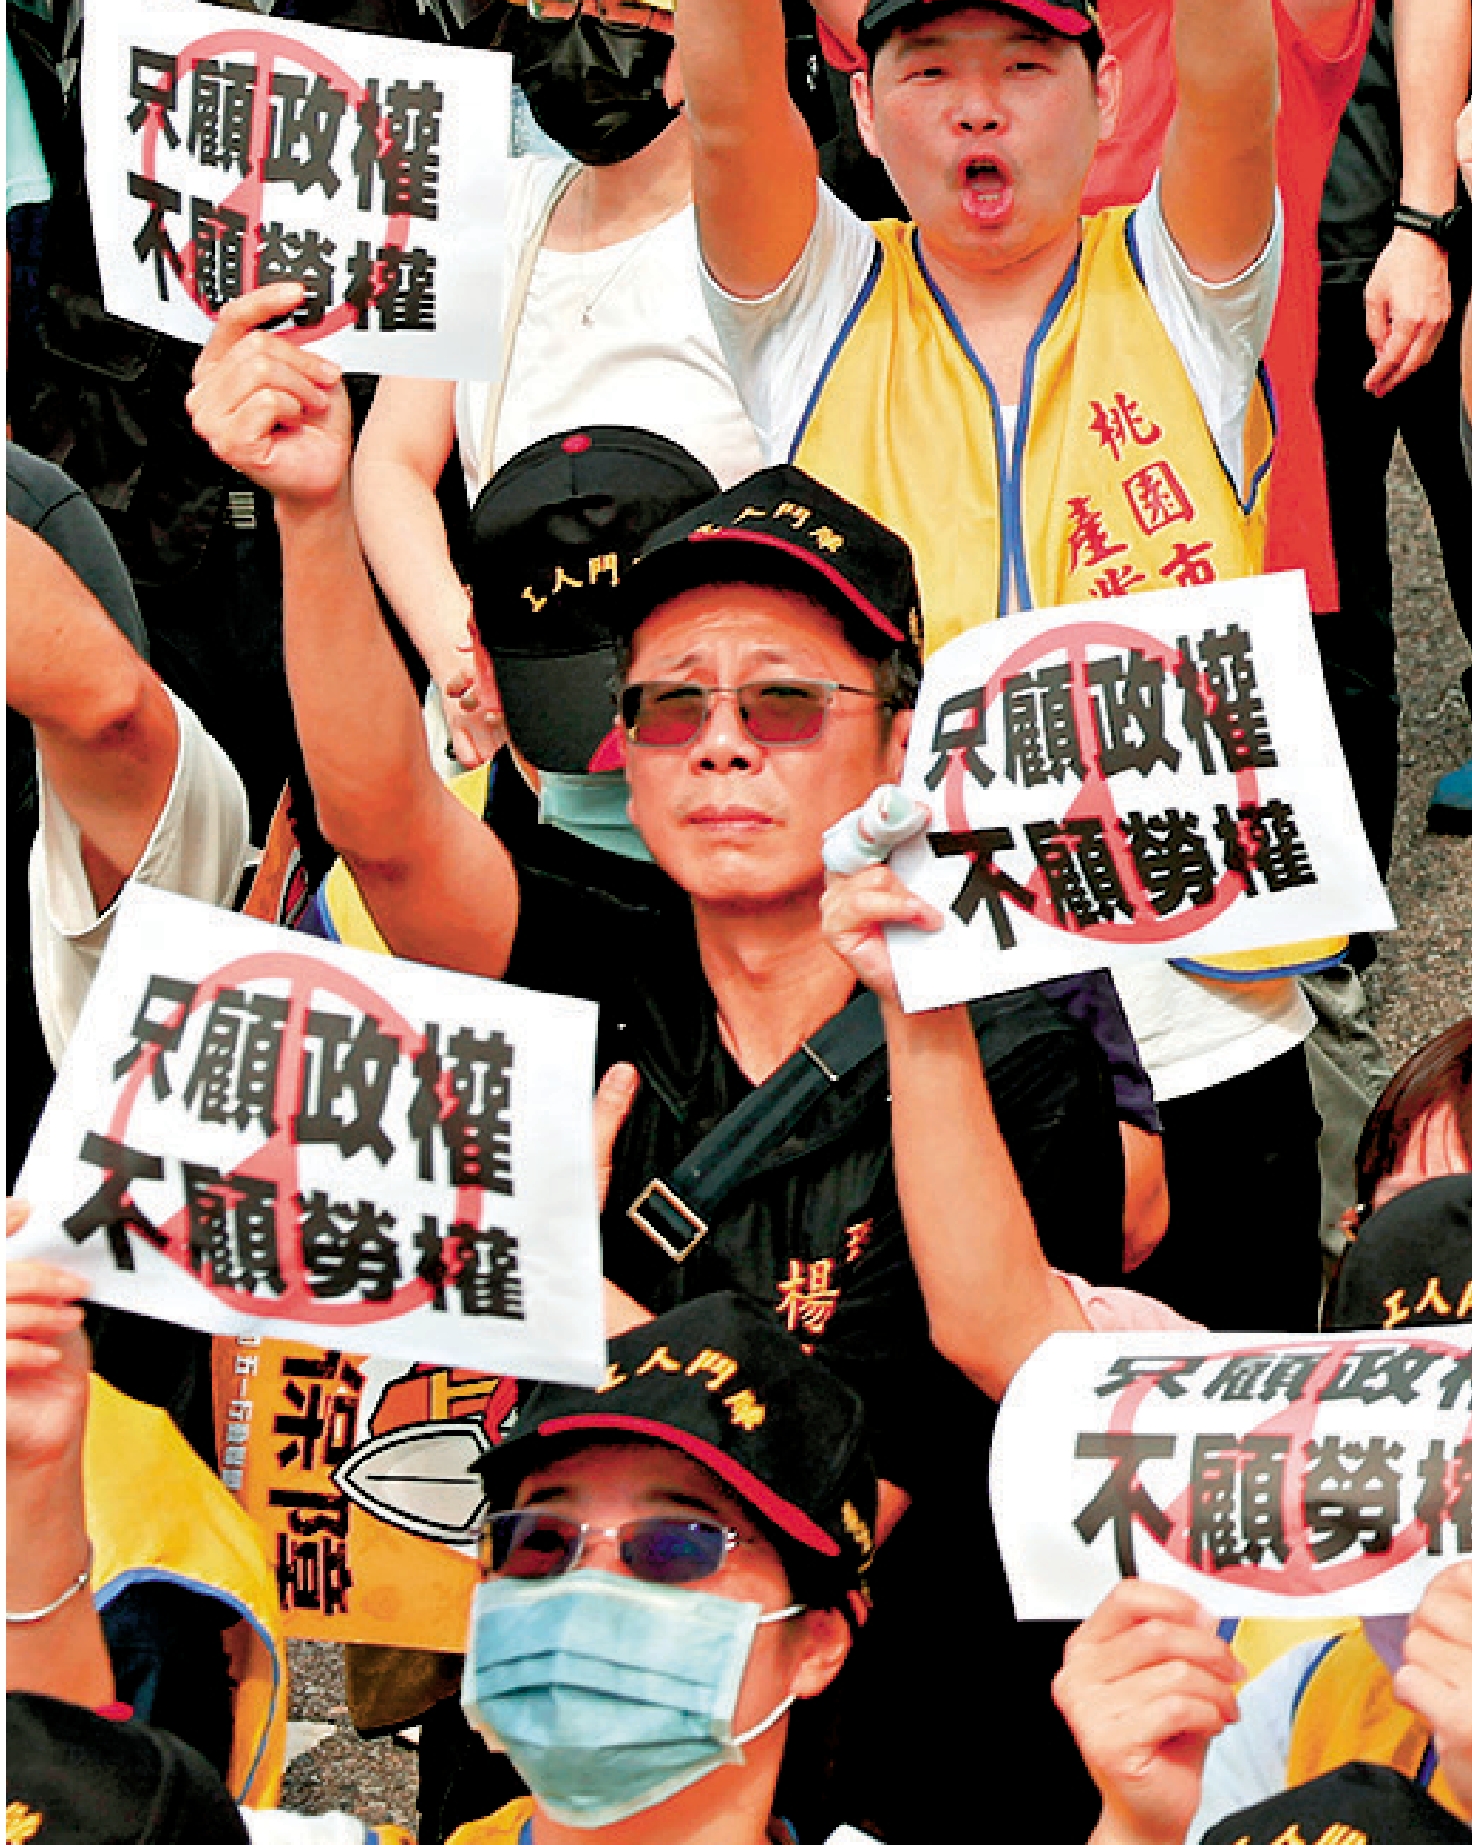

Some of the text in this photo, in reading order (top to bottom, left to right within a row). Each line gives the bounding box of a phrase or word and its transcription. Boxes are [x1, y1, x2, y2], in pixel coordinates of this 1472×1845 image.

[127, 46, 445, 221] 只顧政權
[127, 171, 438, 334] 不顧勞權
[924, 621, 1278, 792] 只顧政權
[930, 797, 1317, 949] 不顧勞權
[111, 973, 516, 1195] 只顧政權
[62, 1131, 525, 1320] 不顧勞權
